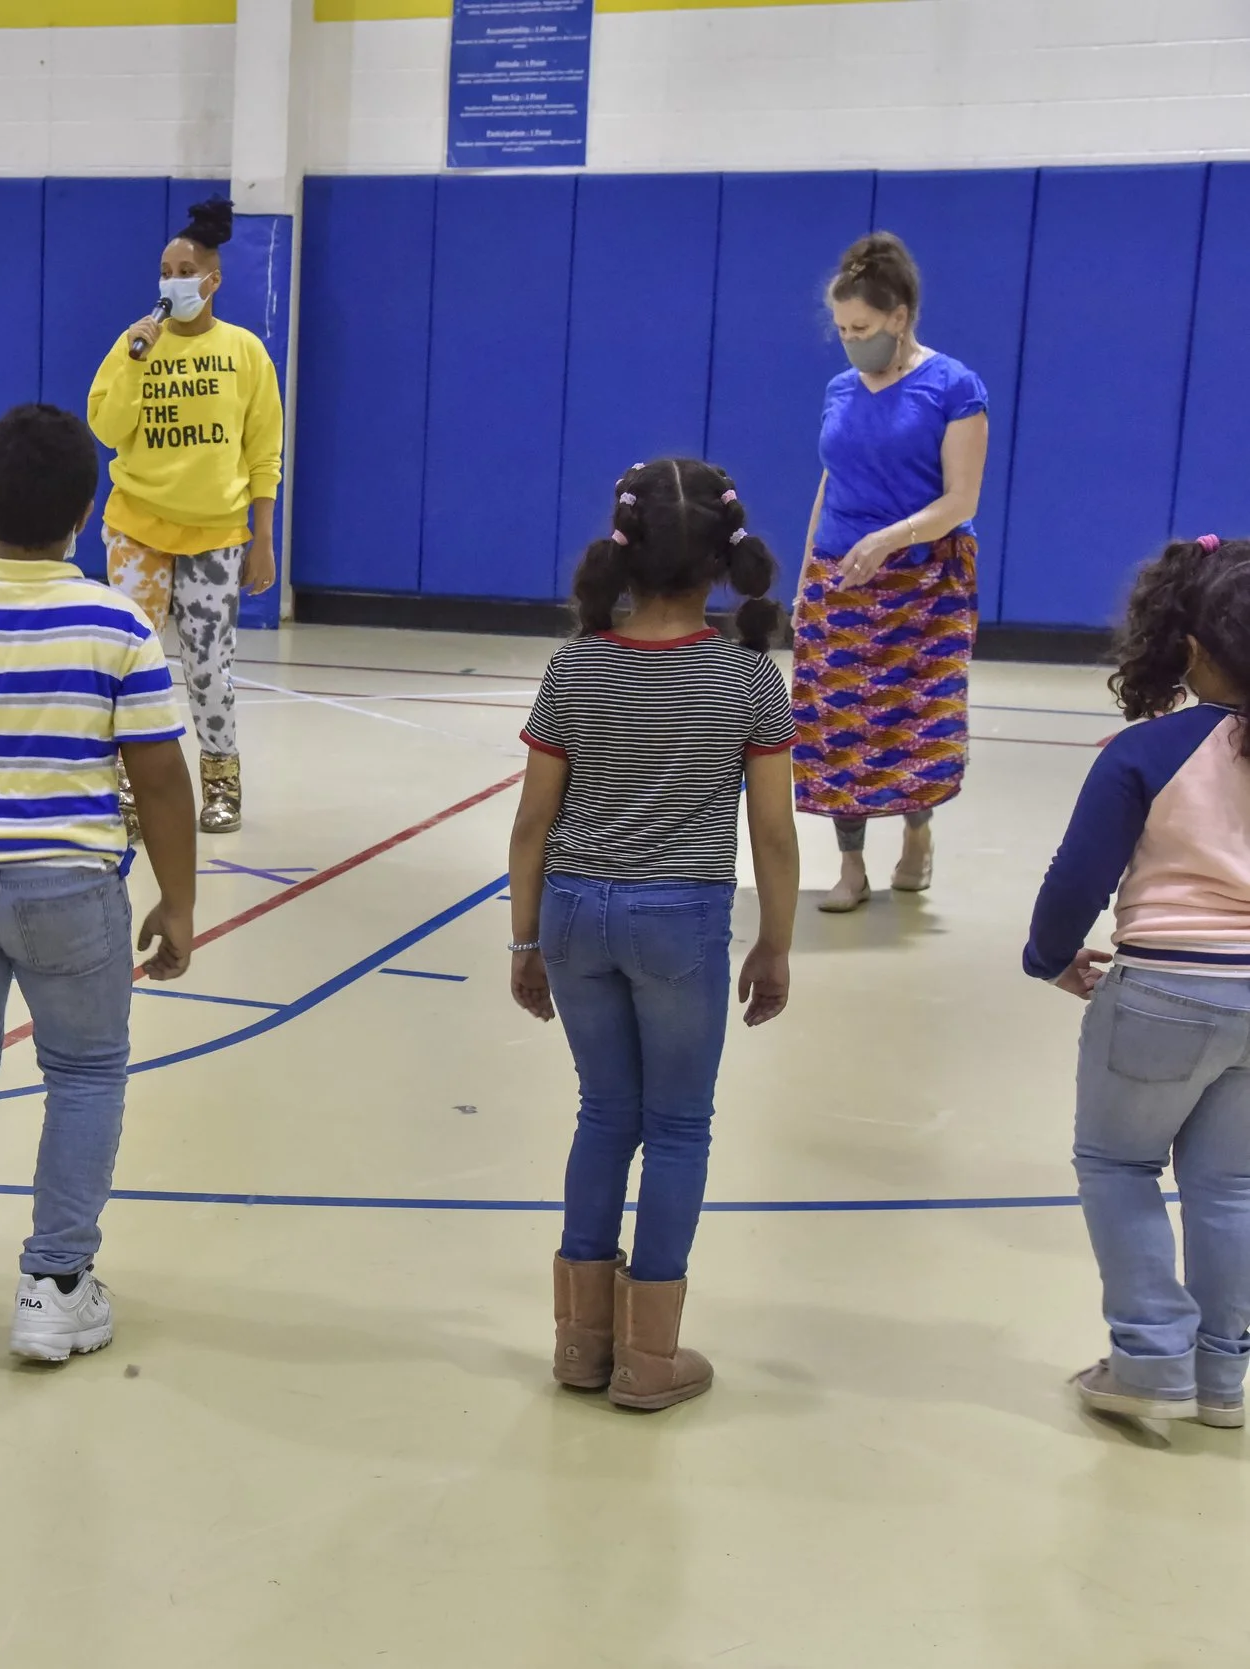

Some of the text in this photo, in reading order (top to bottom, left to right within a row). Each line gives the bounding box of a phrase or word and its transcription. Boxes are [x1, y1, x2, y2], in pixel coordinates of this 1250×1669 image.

[192, 355, 237, 373] WILL
[142, 378, 220, 399] CHANGE
[143, 405, 179, 424] THE
[144, 423, 229, 449] WORLD.
[20, 1298, 43, 1309] FILA
